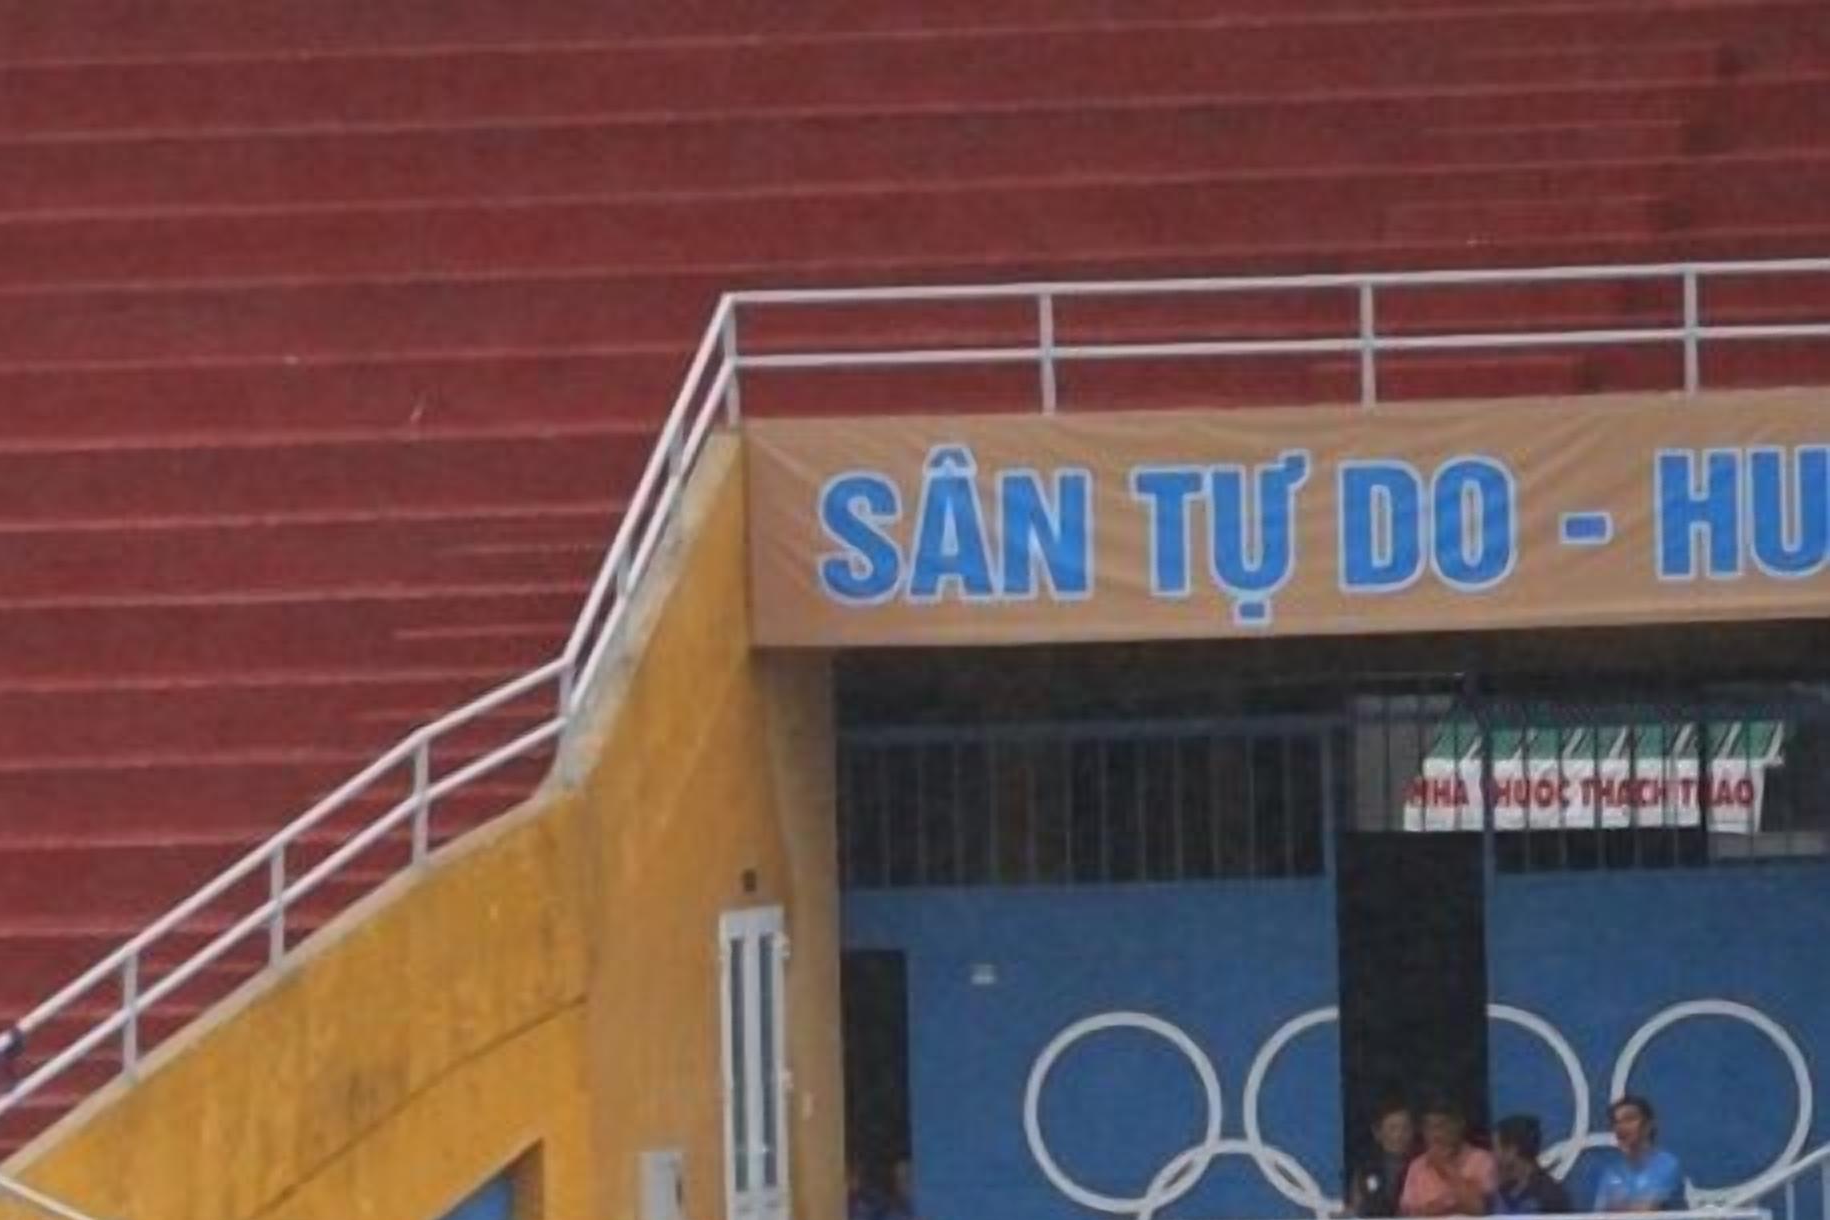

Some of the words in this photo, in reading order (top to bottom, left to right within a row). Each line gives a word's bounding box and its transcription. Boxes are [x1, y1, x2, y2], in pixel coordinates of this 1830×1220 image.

[820, 447, 1091, 602] SÂN
[1130, 450, 1310, 624] TỰ
[1336, 453, 1514, 592] DO
[1655, 446, 1830, 580] HU
